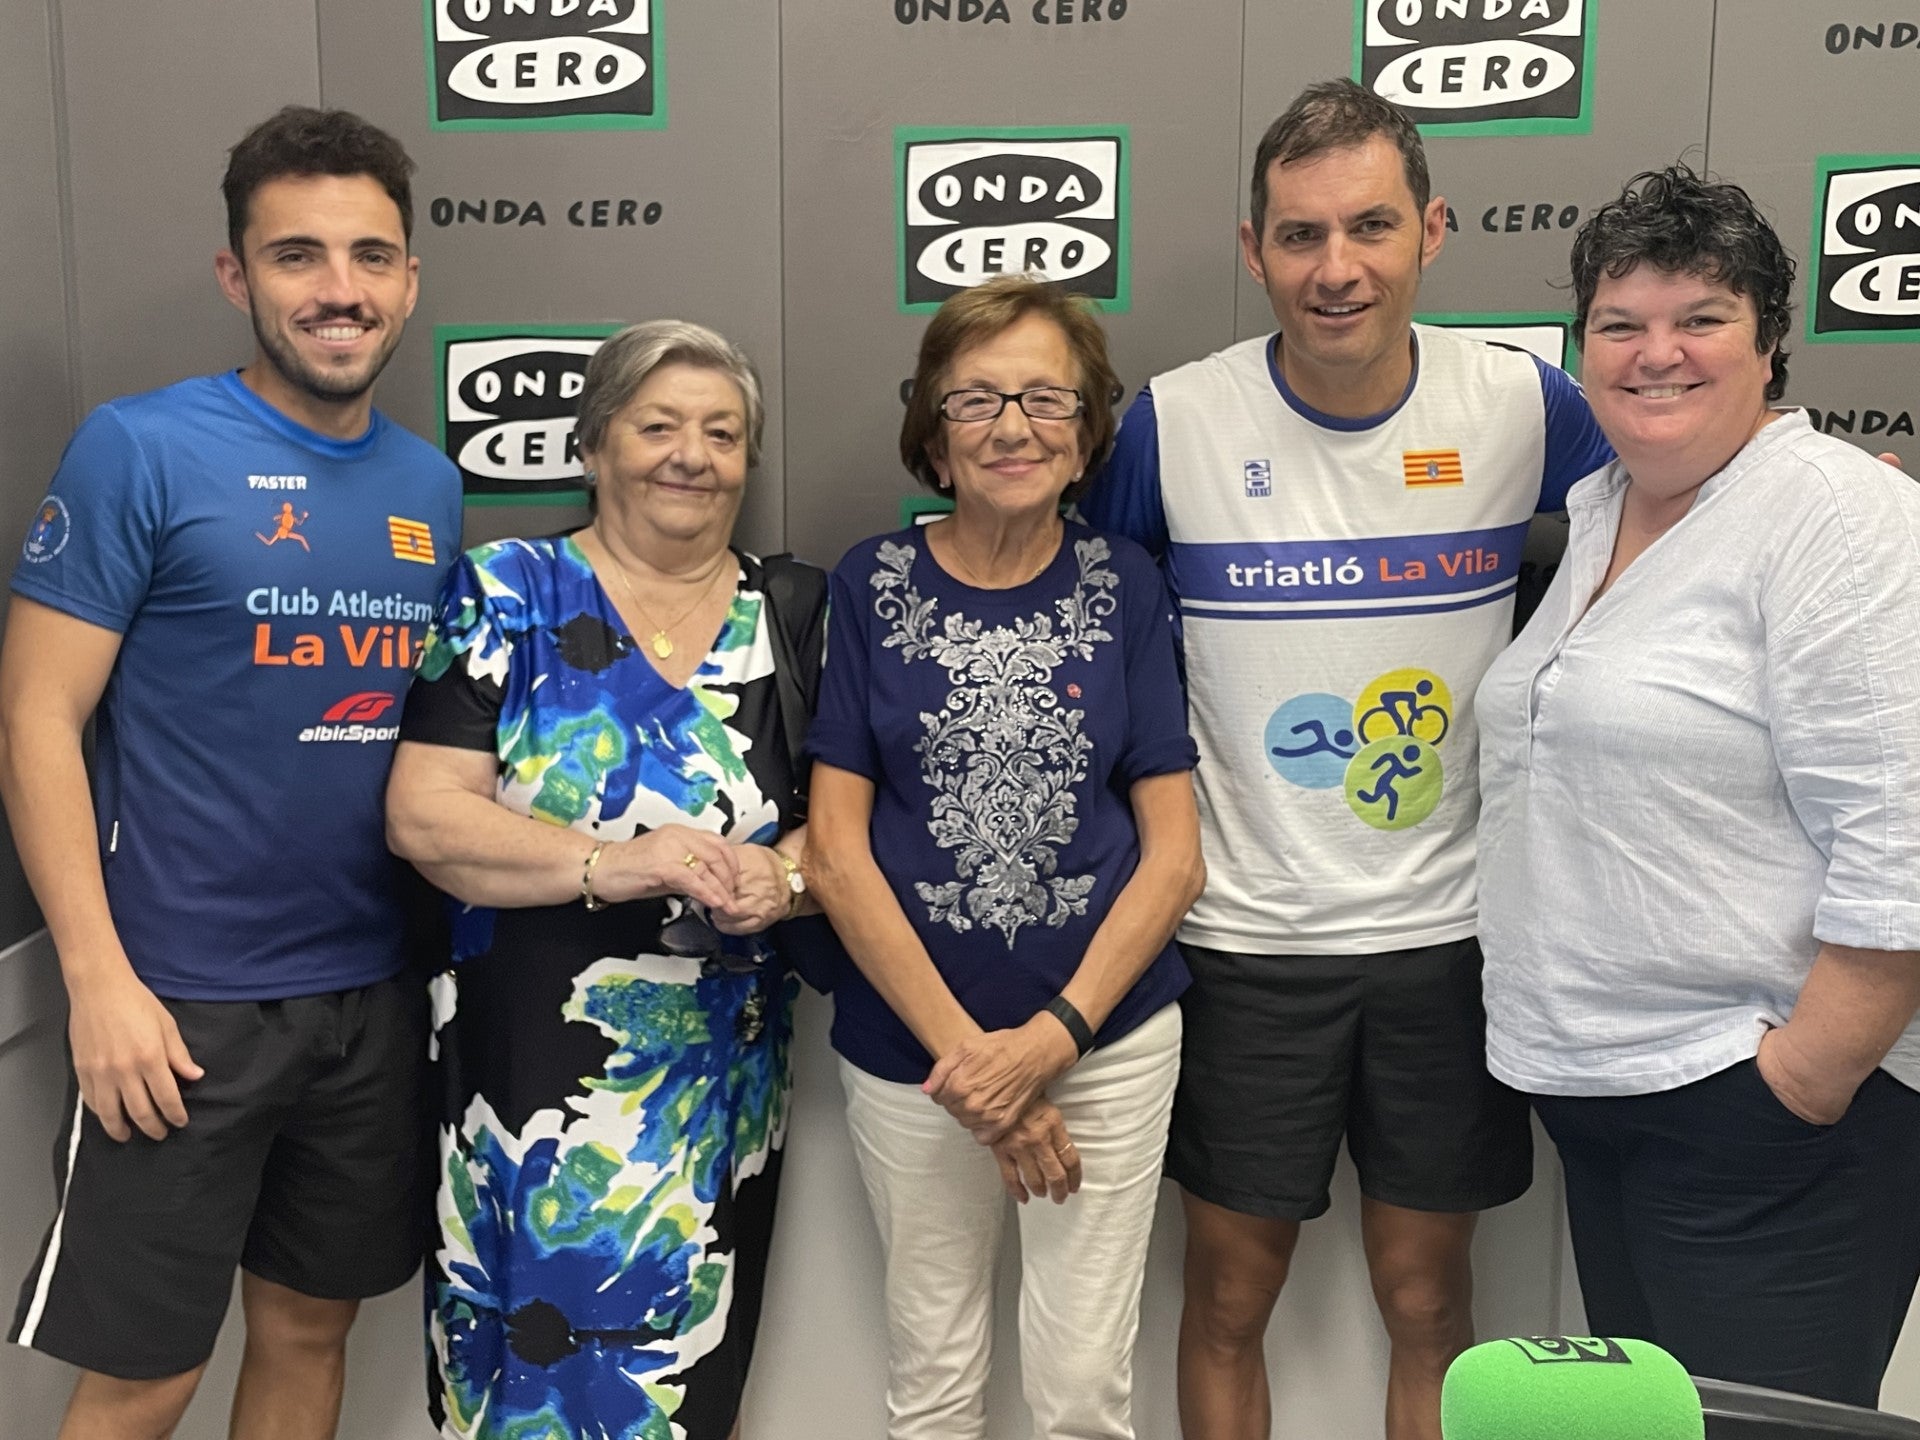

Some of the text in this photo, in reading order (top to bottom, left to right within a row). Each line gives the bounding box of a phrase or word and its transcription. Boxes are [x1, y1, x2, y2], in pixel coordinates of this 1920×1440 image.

[464, 0, 618, 22] ONDA
[894, 0, 1127, 24] ONDA CERO
[1395, 0, 1550, 26] ONDA
[1825, 22, 1920, 54] OND
[476, 52, 618, 88] CERO
[1403, 55, 1548, 93] CERO
[935, 174, 1085, 207] ONDA
[430, 197, 662, 227] ONDA CERO
[1481, 204, 1579, 232] CERO
[945, 238, 1084, 273] CERO
[248, 475, 307, 490] FASTER
[1226, 548, 1499, 587] triatló La Vila
[246, 587, 319, 616] Club
[254, 623, 324, 666] La
